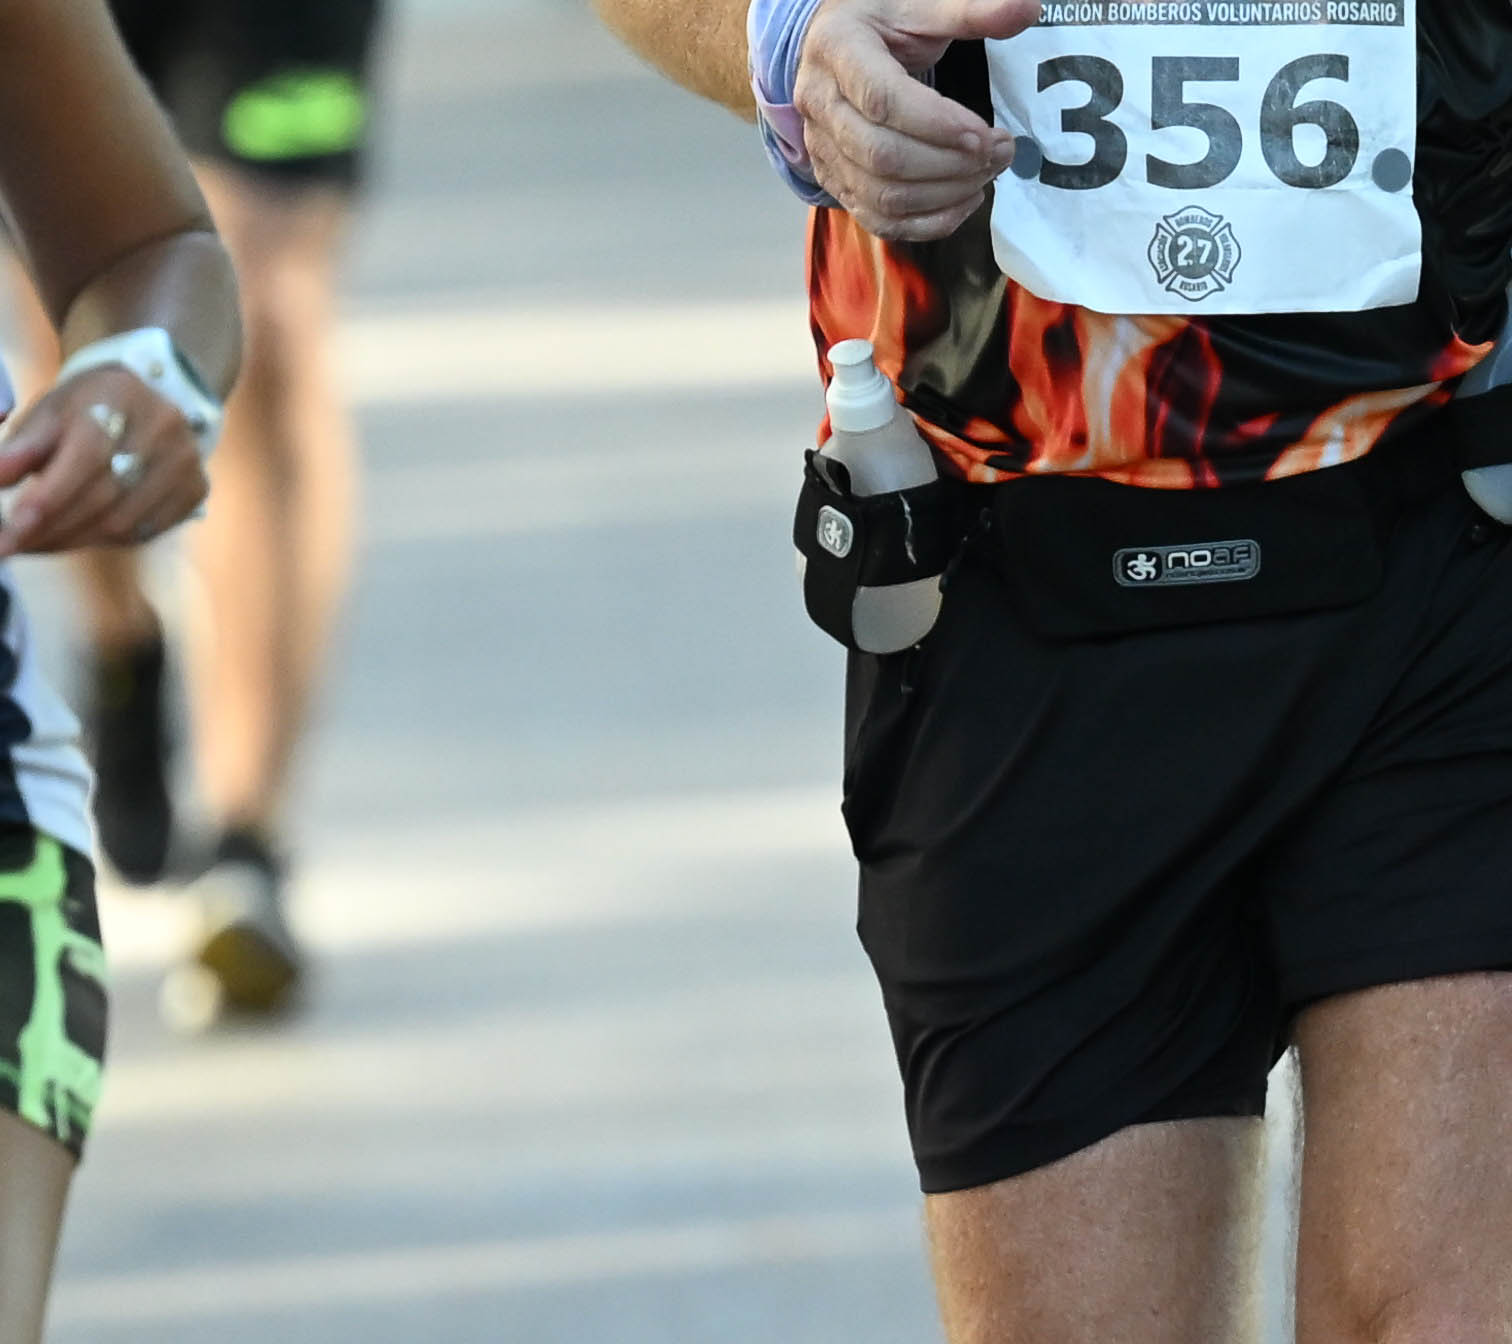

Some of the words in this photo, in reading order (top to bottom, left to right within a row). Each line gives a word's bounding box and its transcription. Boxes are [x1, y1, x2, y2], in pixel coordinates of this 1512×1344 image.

[1107, 2, 1202, 23] BOMBEROS
[1206, 1, 1322, 23] VOLUNTARIOS
[1326, 0, 1397, 23] ROSARIO
[1036, 53, 1360, 191] 356
[1176, 234, 1213, 267] 27
